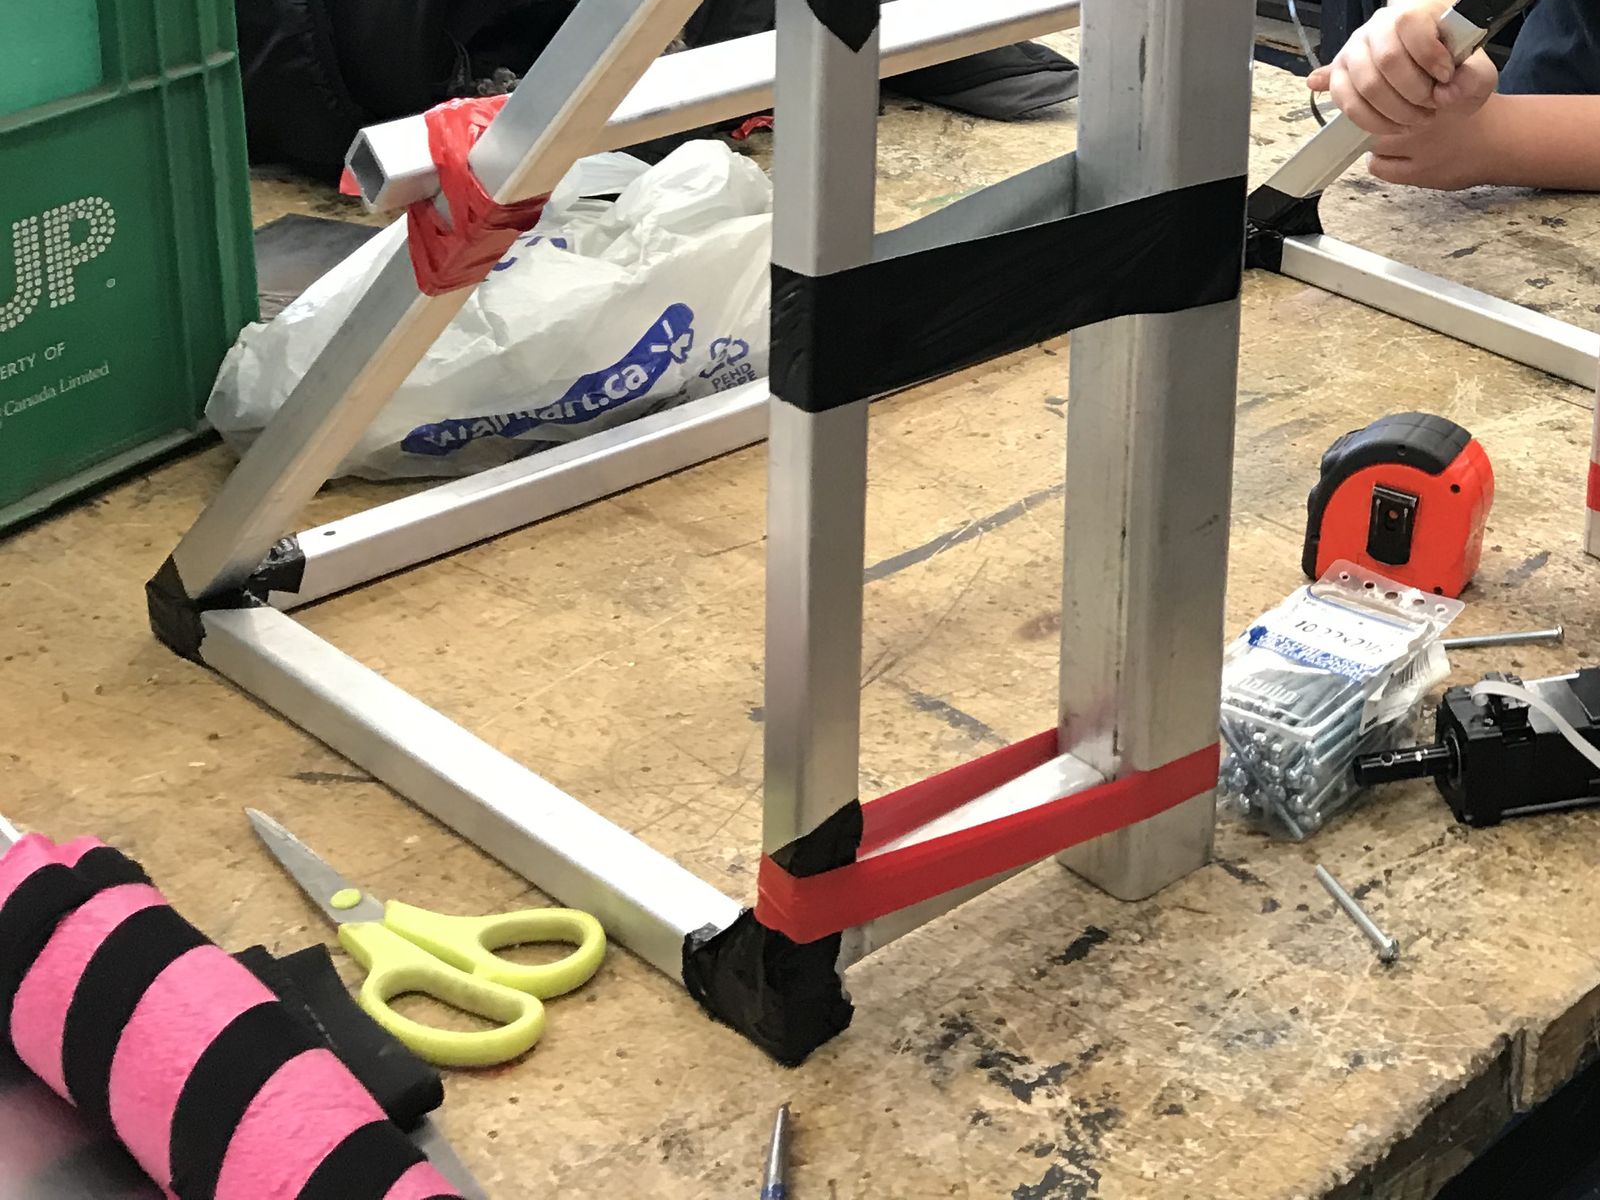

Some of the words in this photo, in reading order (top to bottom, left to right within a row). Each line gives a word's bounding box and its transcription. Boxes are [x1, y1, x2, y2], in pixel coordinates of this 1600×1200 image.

[44, 341, 65, 361] OF
[4, 385, 57, 416] Canada
[60, 360, 110, 393] Limited
